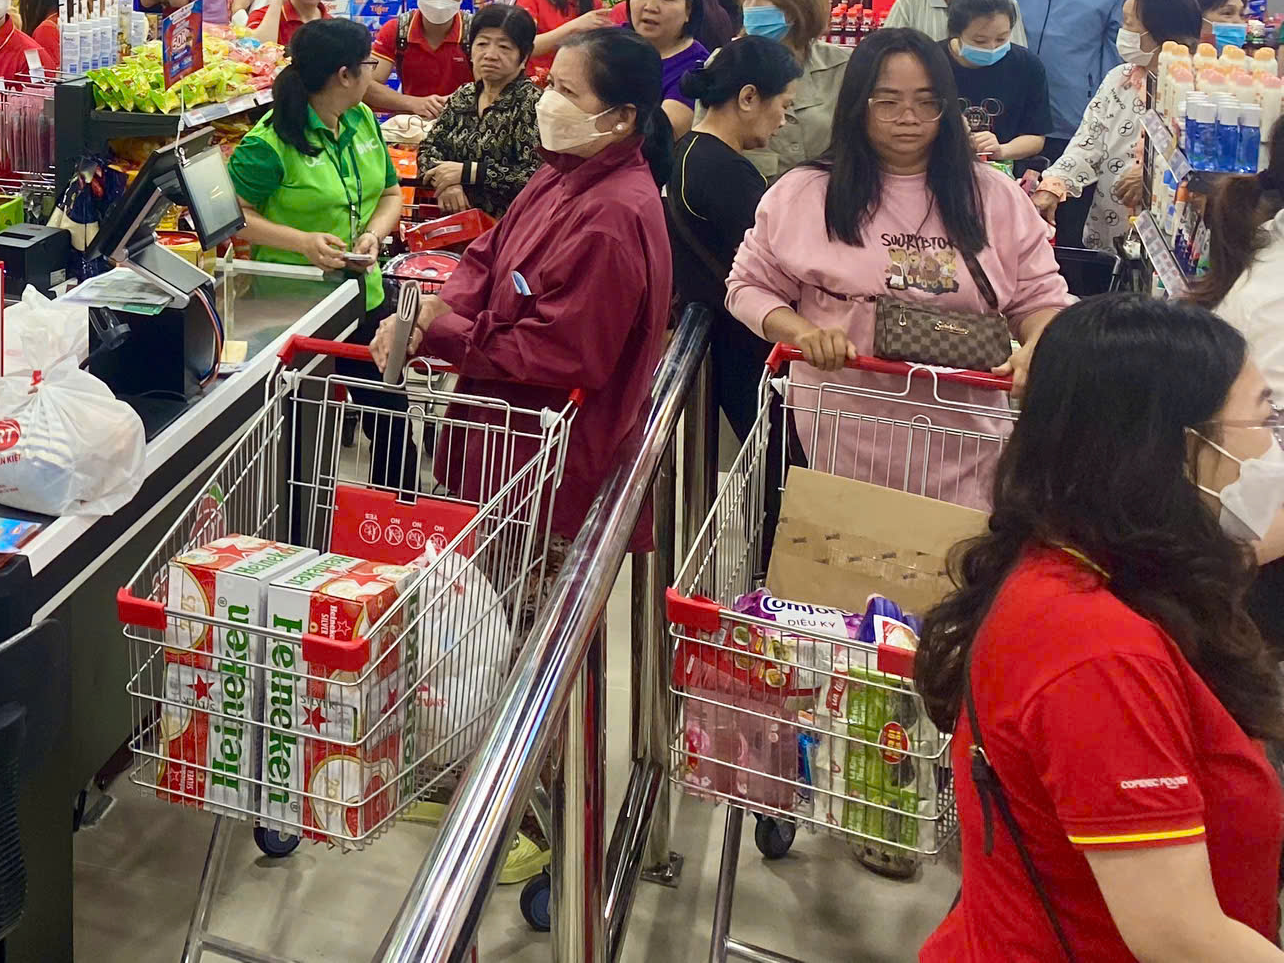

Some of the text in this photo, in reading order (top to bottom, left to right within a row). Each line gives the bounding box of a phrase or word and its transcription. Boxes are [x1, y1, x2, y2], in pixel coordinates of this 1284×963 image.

[412, 521, 422, 529] NO
[434, 525, 445, 533] NO
[233, 546, 305, 575] Heineken
[285, 555, 355, 586] Heineken
[320, 613, 329, 635] SILVER
[211, 604, 249, 792] Heineken
[268, 614, 303, 804] Heineken
